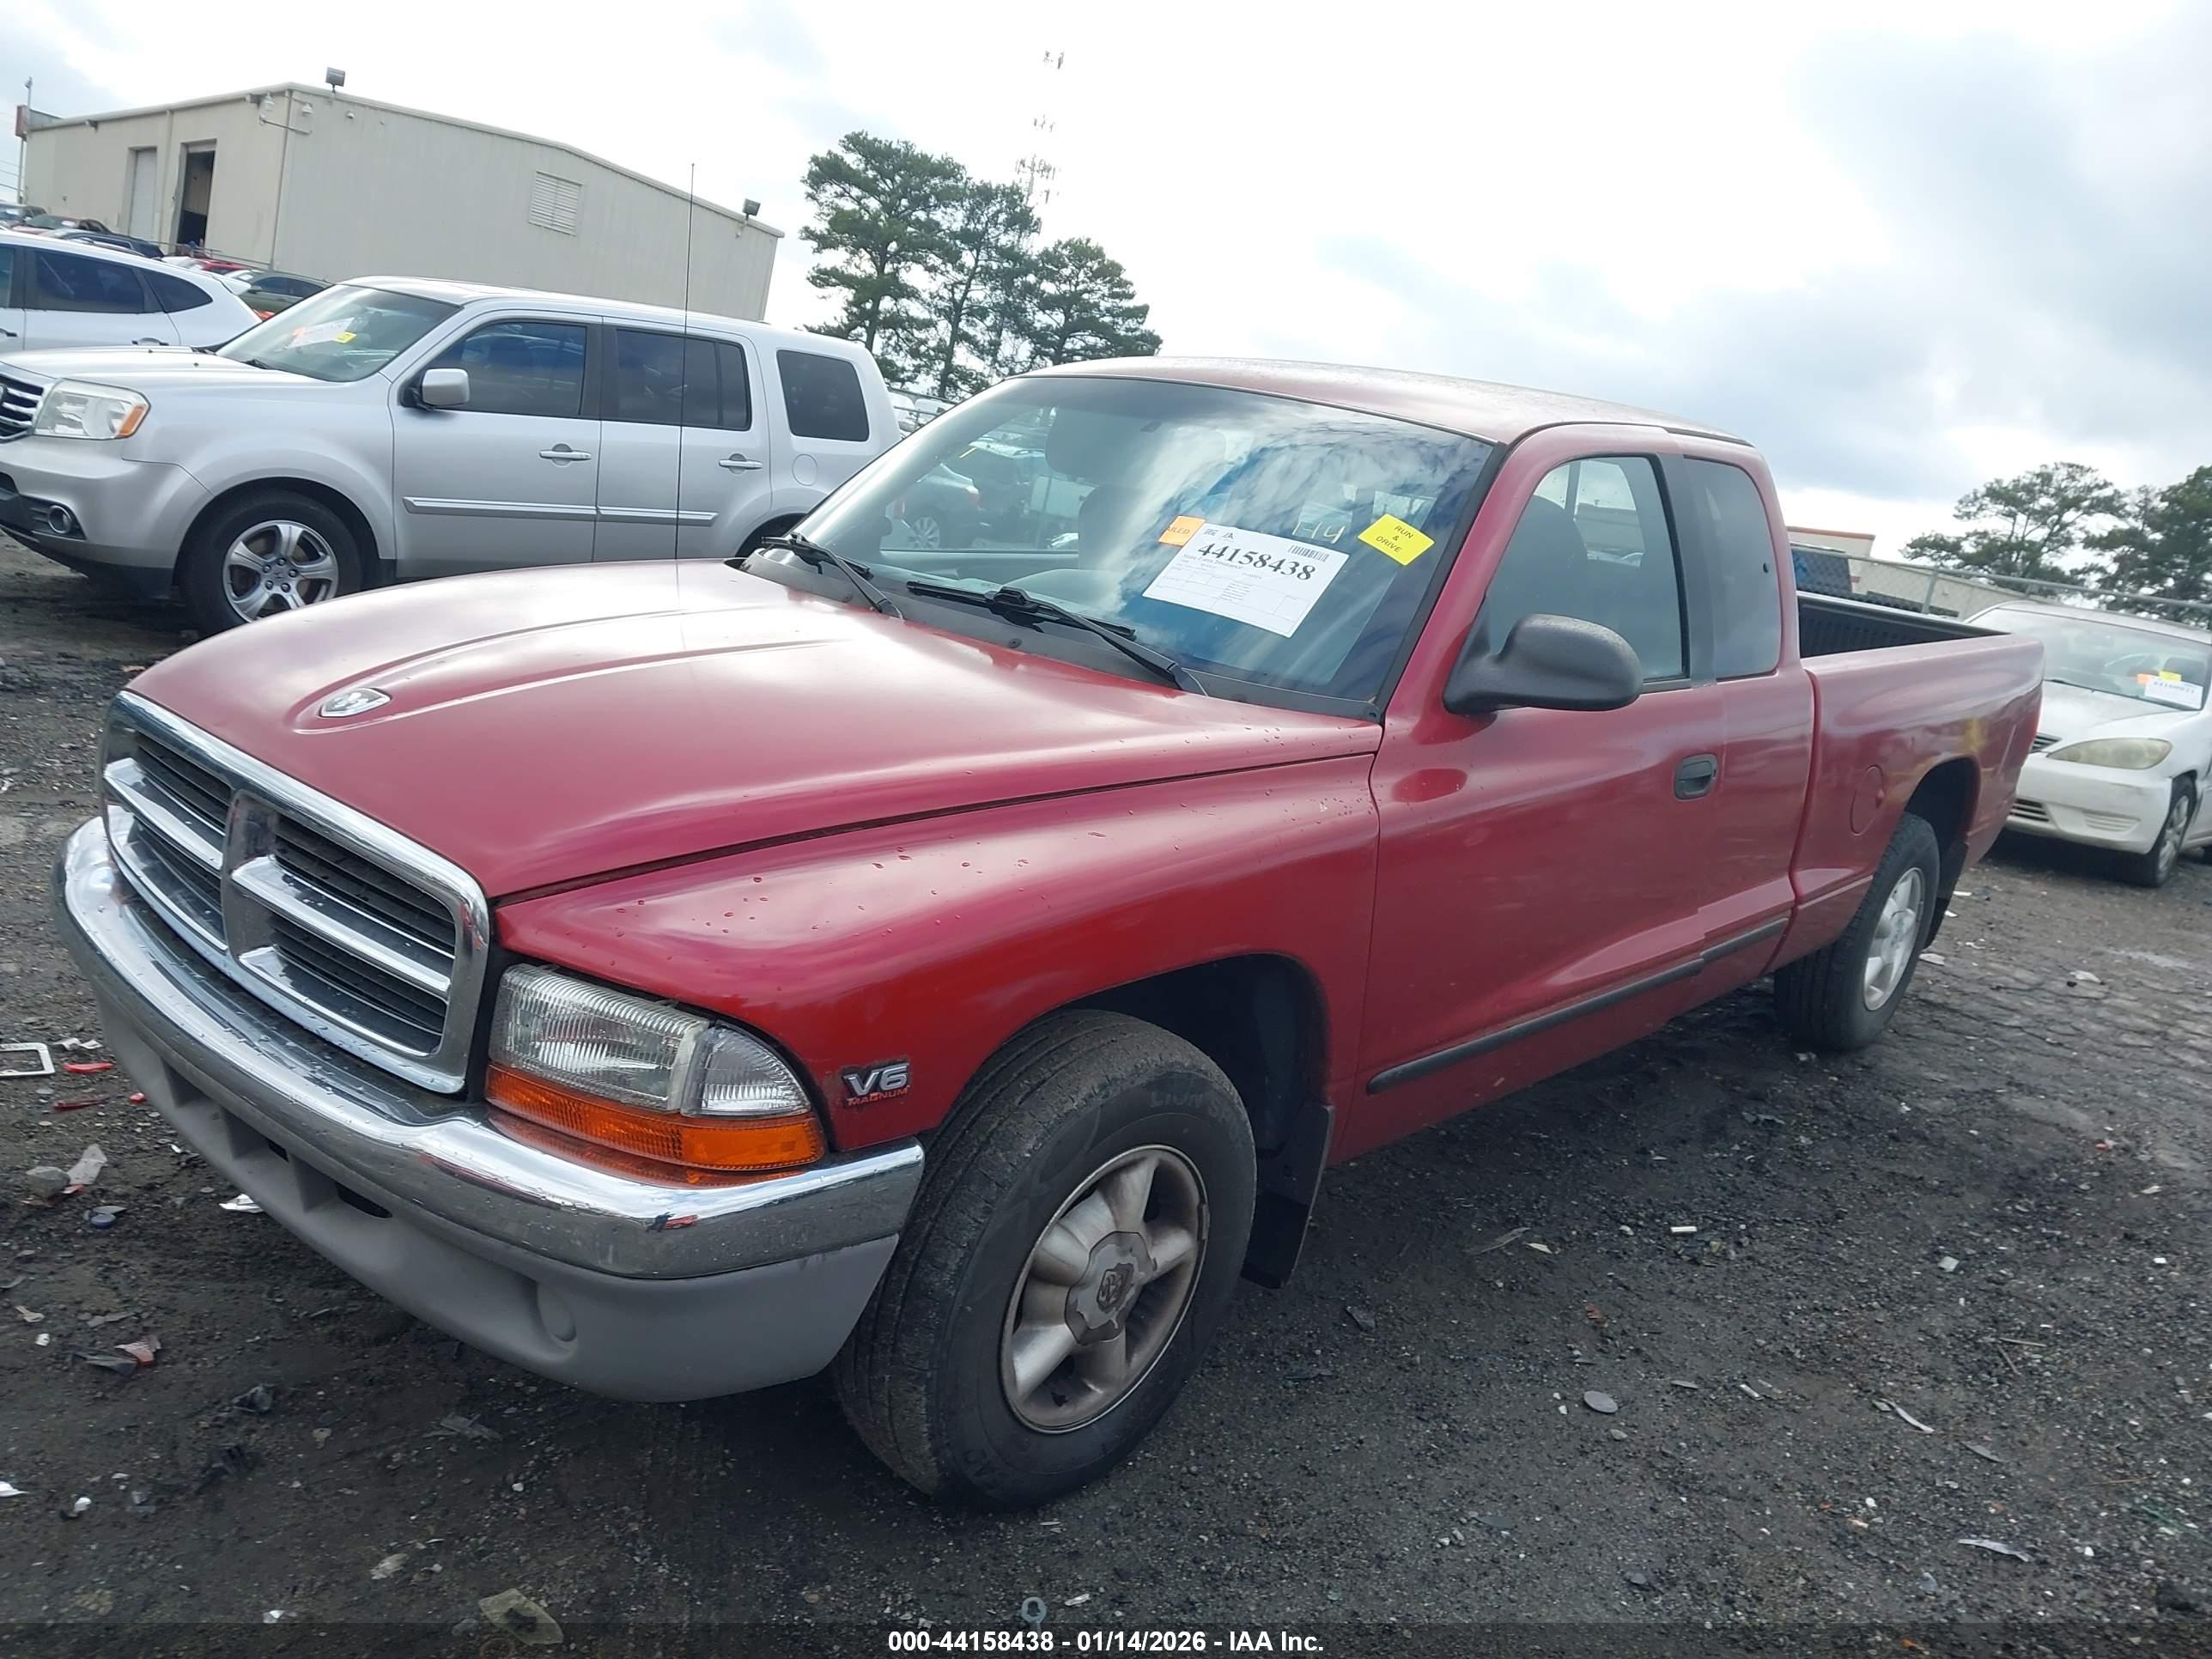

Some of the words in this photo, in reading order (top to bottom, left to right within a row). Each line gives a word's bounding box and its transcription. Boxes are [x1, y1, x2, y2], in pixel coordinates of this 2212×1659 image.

[1394, 525, 1414, 539] RUN
[1376, 535, 1402, 553] DRIVE
[1197, 543, 1316, 581] 44158438
[842, 1062, 909, 1096] V6
[845, 1085, 909, 1107] MAGNUM
